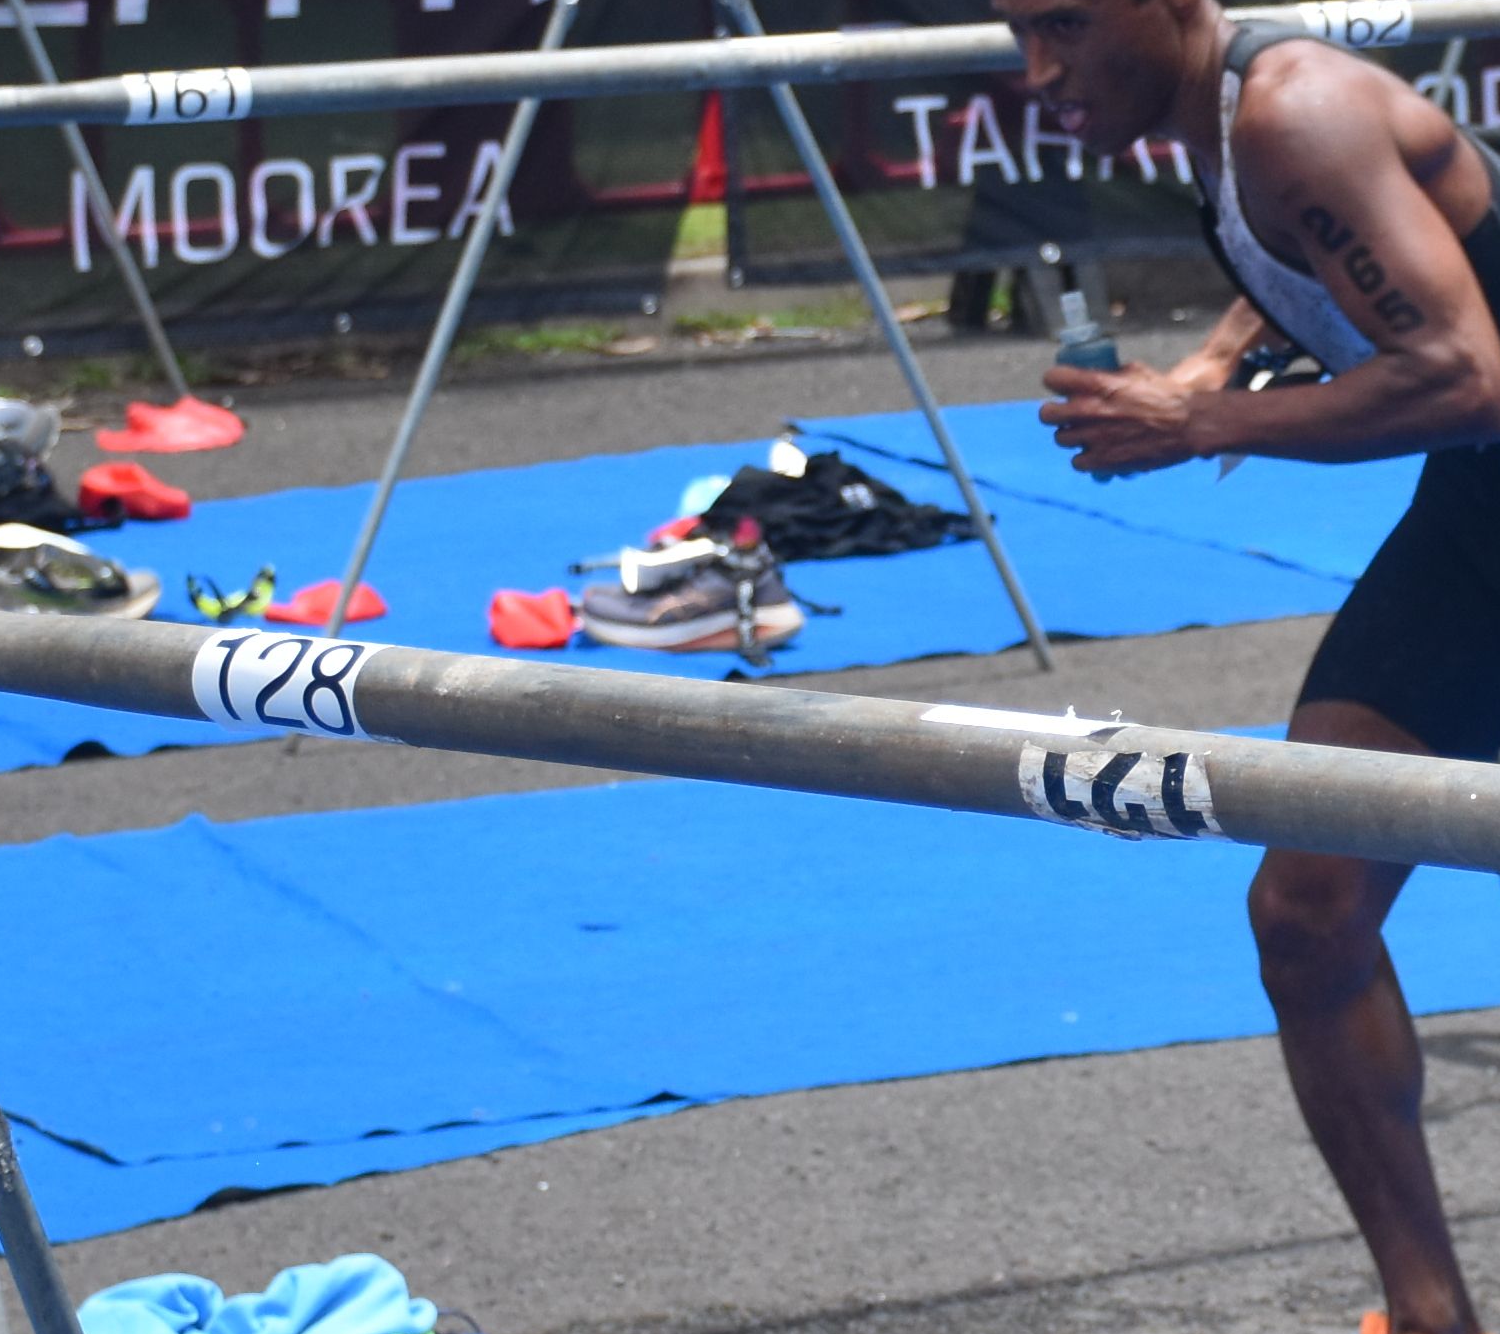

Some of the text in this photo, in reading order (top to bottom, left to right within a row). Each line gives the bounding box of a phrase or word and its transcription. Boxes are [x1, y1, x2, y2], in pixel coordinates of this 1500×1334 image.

[143, 69, 238, 119] 161
[70, 140, 515, 272] MOOREA
[211, 632, 367, 738] 128
